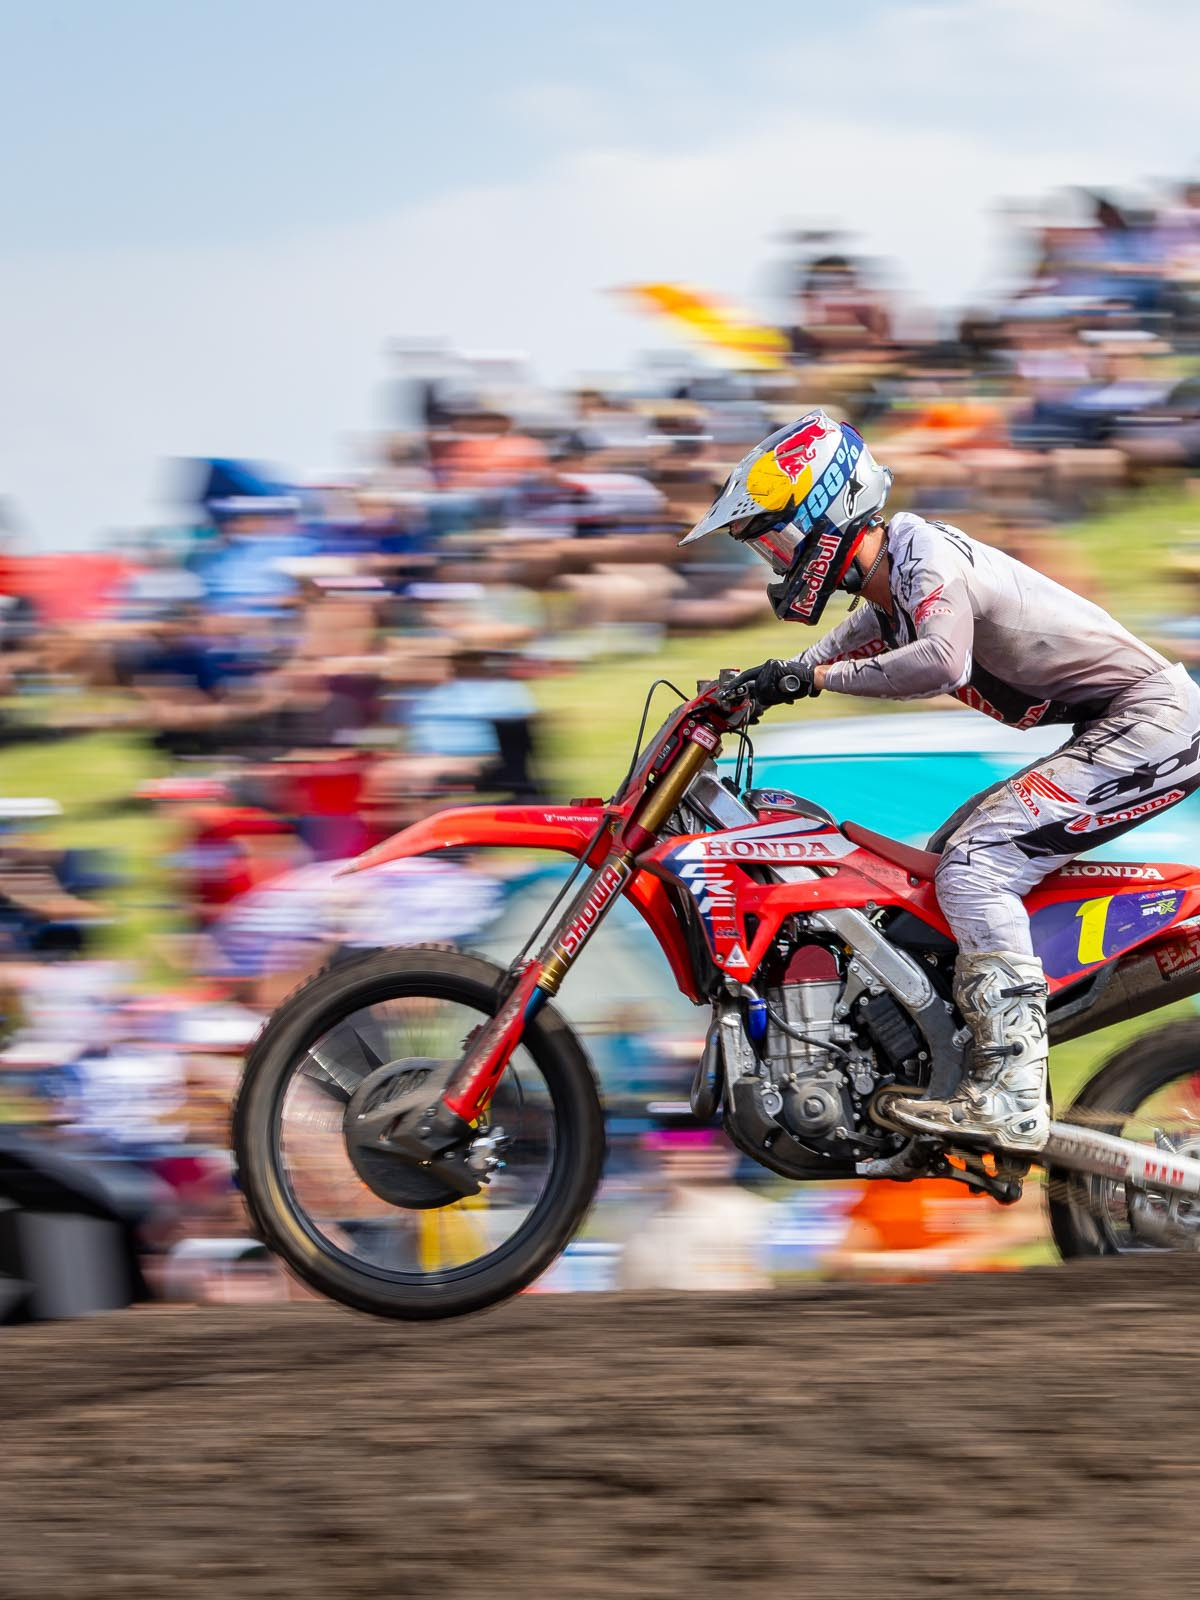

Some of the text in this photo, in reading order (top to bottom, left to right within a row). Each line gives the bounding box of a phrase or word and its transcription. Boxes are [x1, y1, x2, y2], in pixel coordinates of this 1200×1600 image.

[794, 437, 860, 533] 100%
[1095, 790, 1183, 827] HONDA
[702, 840, 835, 858] HONDA
[1060, 865, 1164, 880] HONDA
[563, 869, 619, 956] SHOWA
[1075, 895, 1114, 965] 1
